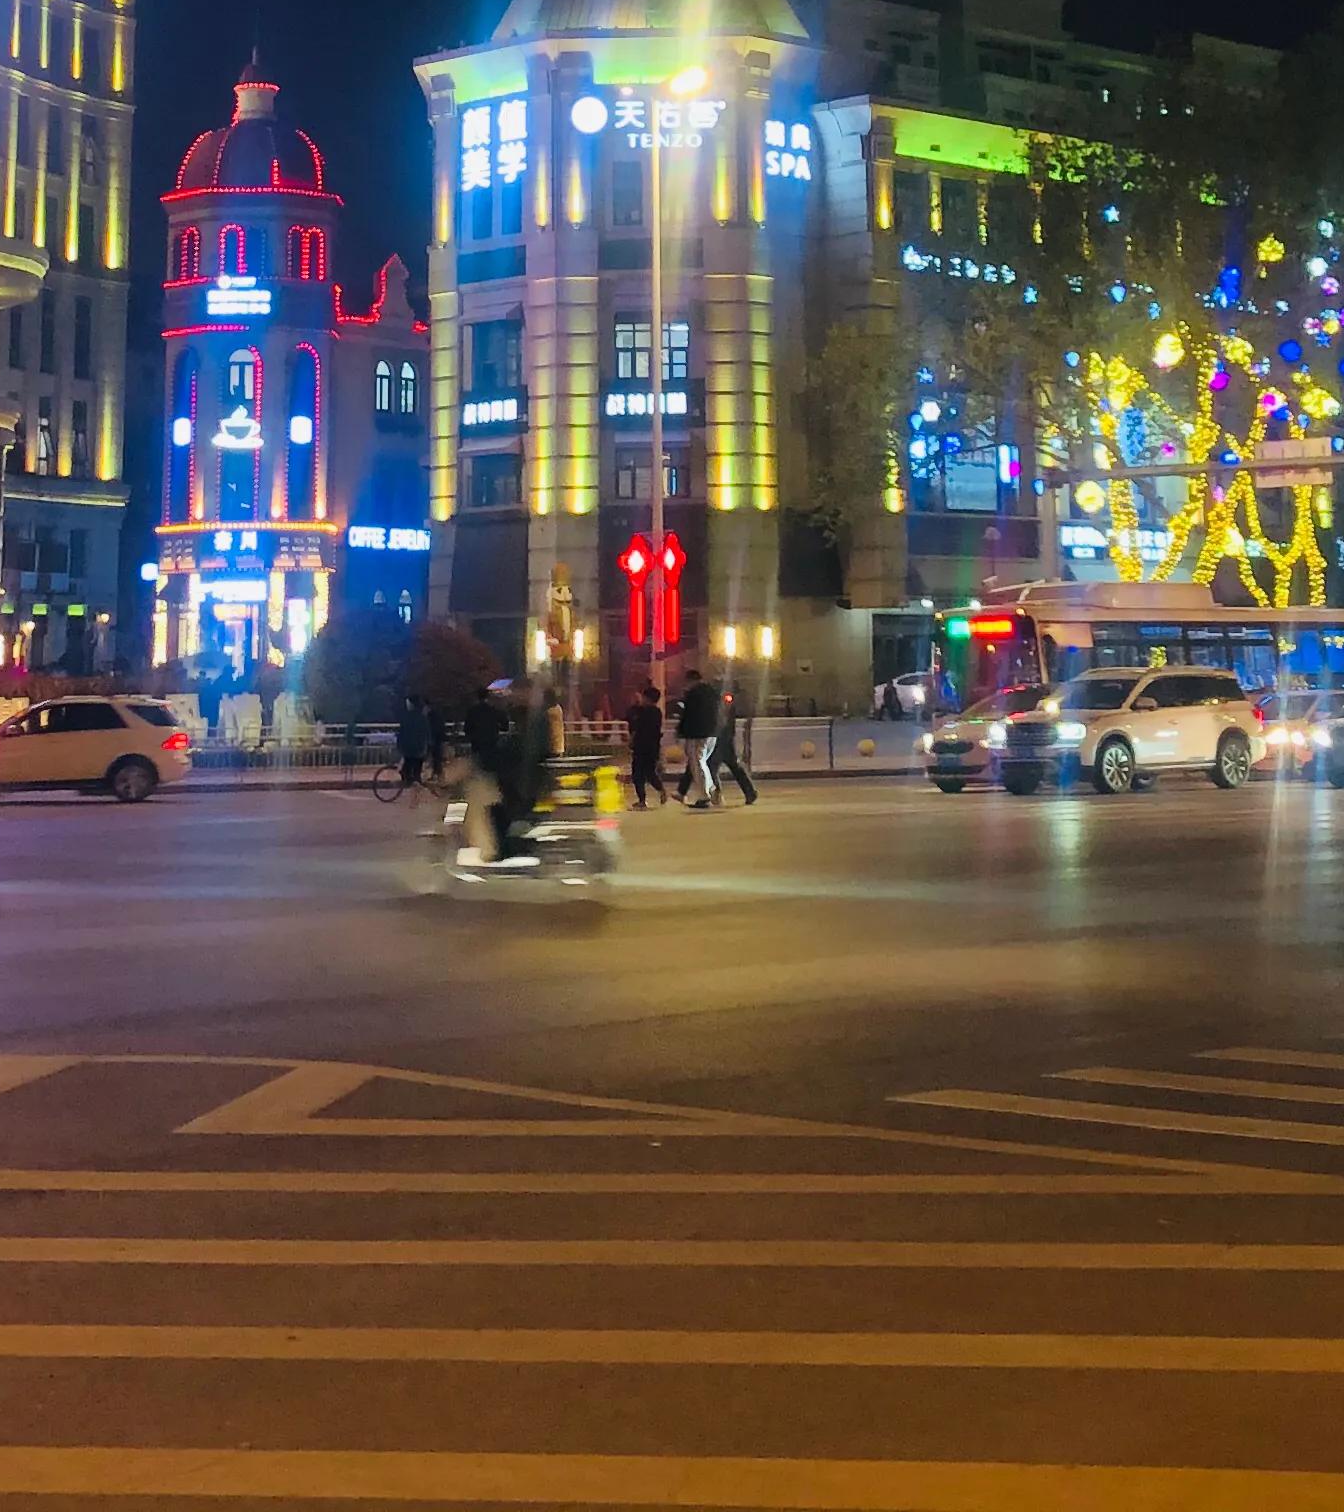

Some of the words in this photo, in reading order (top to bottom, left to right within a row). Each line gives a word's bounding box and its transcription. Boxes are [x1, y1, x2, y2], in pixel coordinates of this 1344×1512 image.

[627, 133, 703, 149] TENZO
[766, 150, 811, 180] SPA
[349, 526, 386, 550] COFFEE
